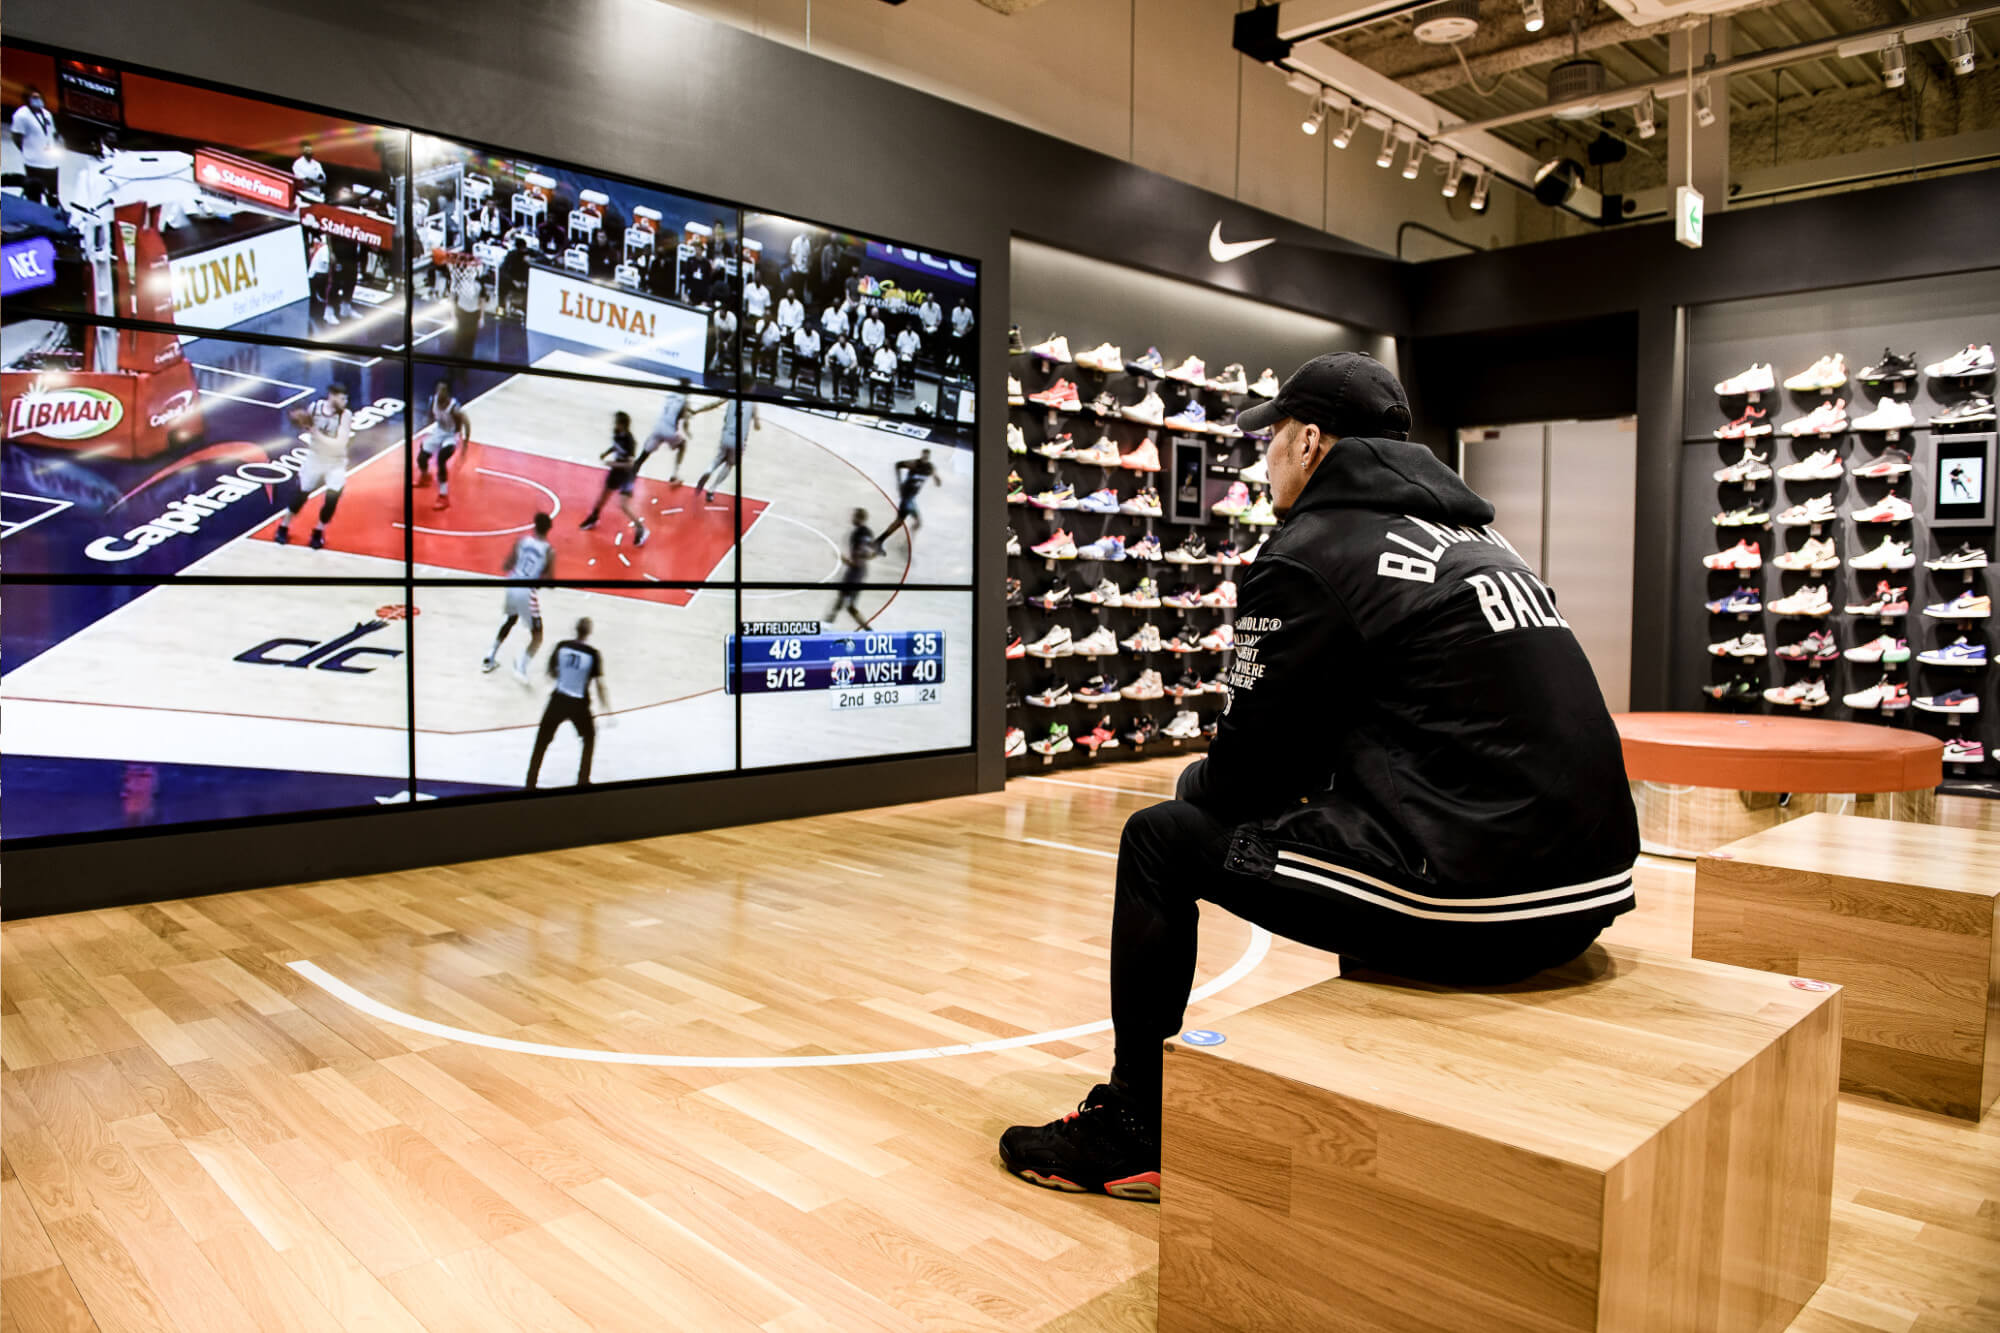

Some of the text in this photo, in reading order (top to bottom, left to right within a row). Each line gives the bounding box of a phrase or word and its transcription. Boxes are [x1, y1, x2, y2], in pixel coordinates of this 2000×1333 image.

[8, 249, 47, 280] NEC
[559, 289, 657, 338] LiUNA!
[11, 400, 113, 434] LIBMAN
[743, 622, 818, 635] 3-PT FIELD GOALS
[768, 639, 802, 660] 4/8
[865, 633, 937, 656] ORL 35
[766, 667, 806, 689] 5/12
[864, 659, 937, 683] WSH 40
[839, 692, 864, 707] 2nd
[873, 690, 899, 705] 9:03
